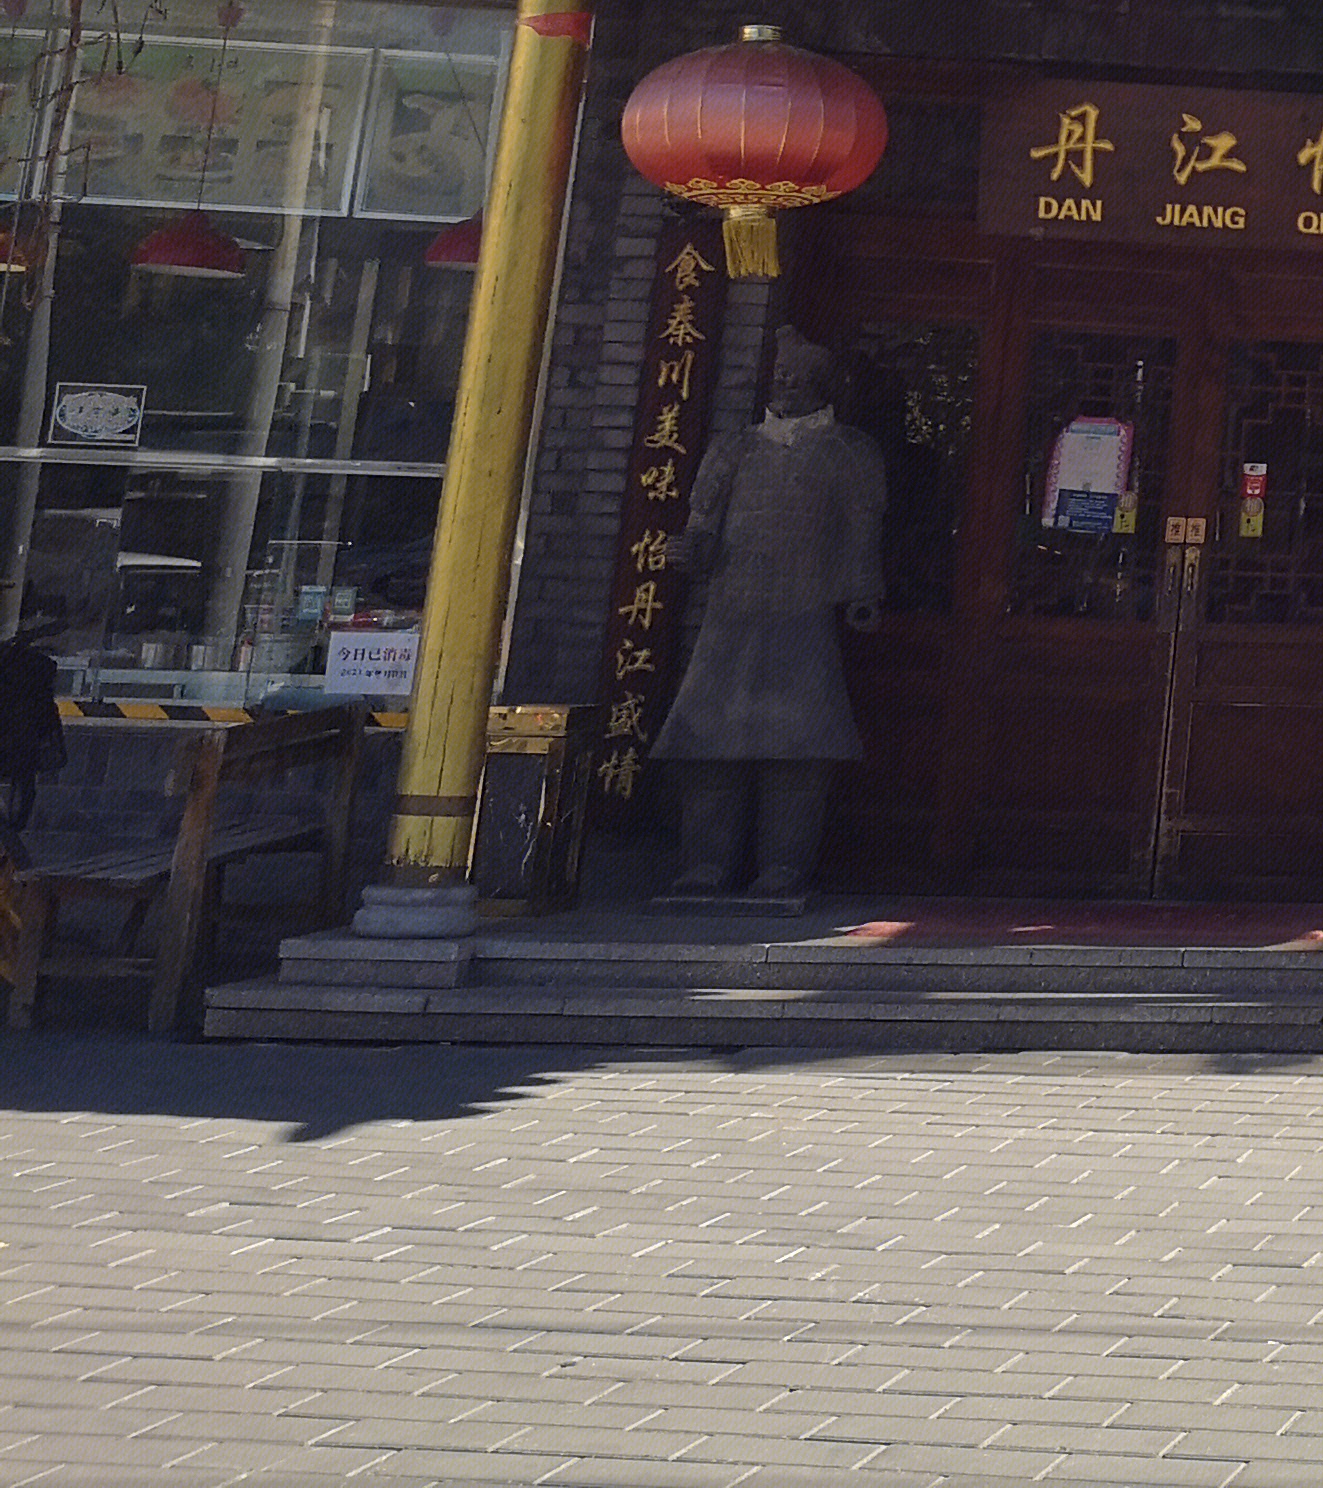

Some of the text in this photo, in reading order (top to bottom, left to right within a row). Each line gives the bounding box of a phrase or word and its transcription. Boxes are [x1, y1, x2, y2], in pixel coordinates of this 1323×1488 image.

[1038, 196, 1102, 222] DAN
[1156, 202, 1246, 229] JIANG
[338, 647, 411, 662] 今日已消毒
